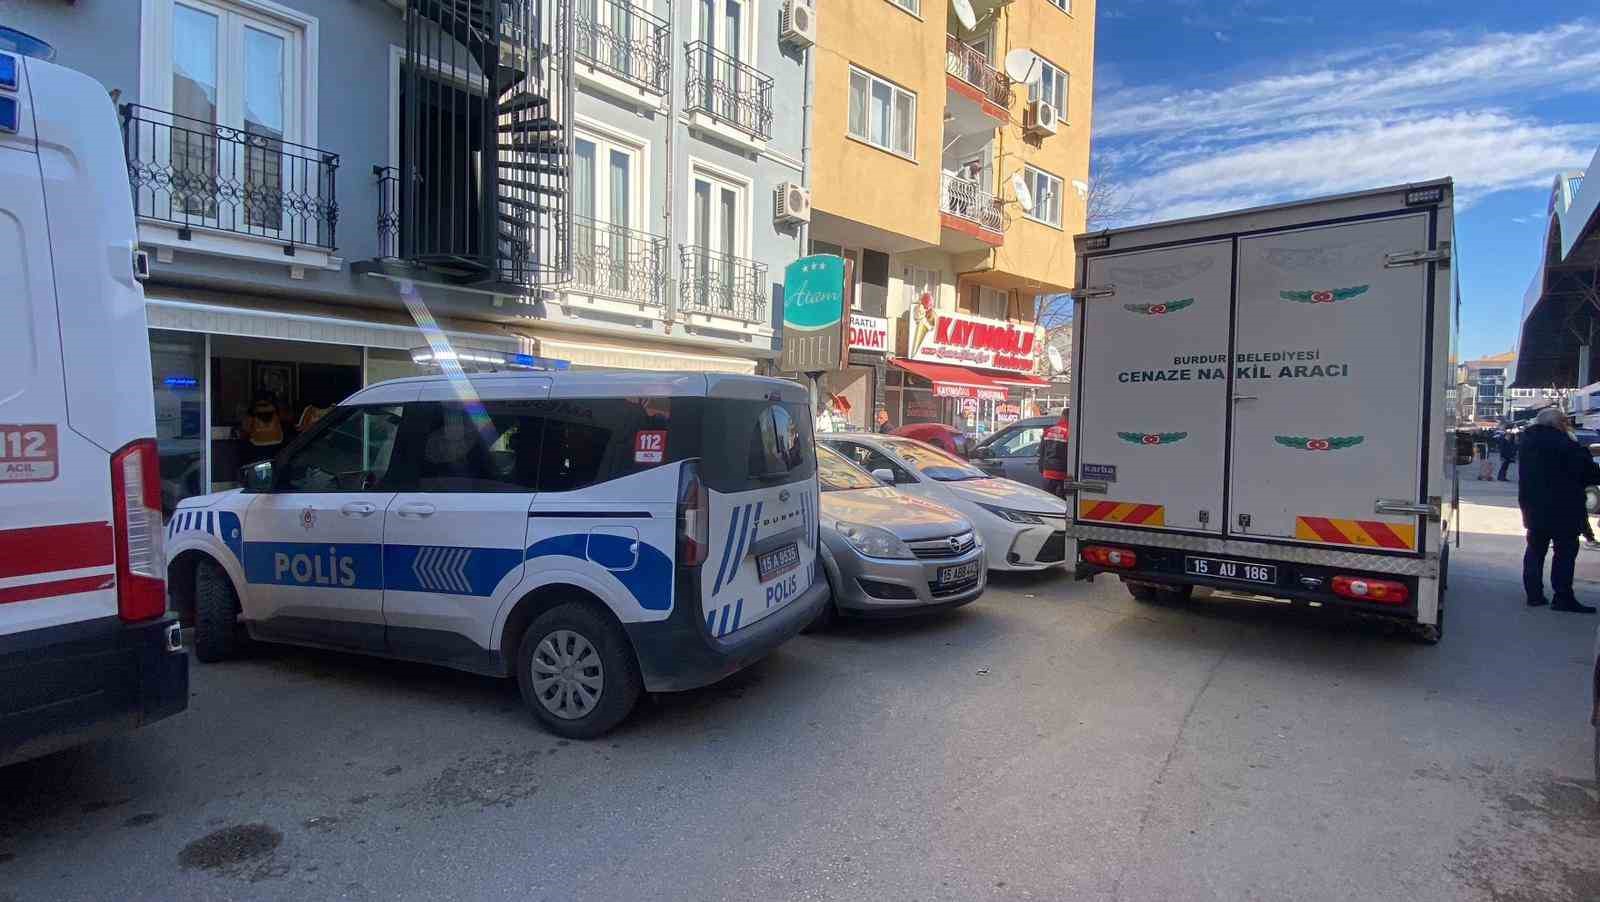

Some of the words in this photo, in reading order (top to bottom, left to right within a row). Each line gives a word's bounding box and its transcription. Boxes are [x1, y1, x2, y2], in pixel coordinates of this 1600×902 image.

[787, 335, 832, 365] HOTEL
[1174, 354, 1227, 366] BURDUR
[1237, 347, 1320, 363] BELEDİYESİ
[1118, 369, 1191, 383] CENAZE
[1278, 363, 1348, 378] ARACI
[640, 434, 661, 450] 112
[1194, 559, 1209, 573] 15
[1219, 562, 1237, 577] AU
[1244, 566, 1268, 581] 186
